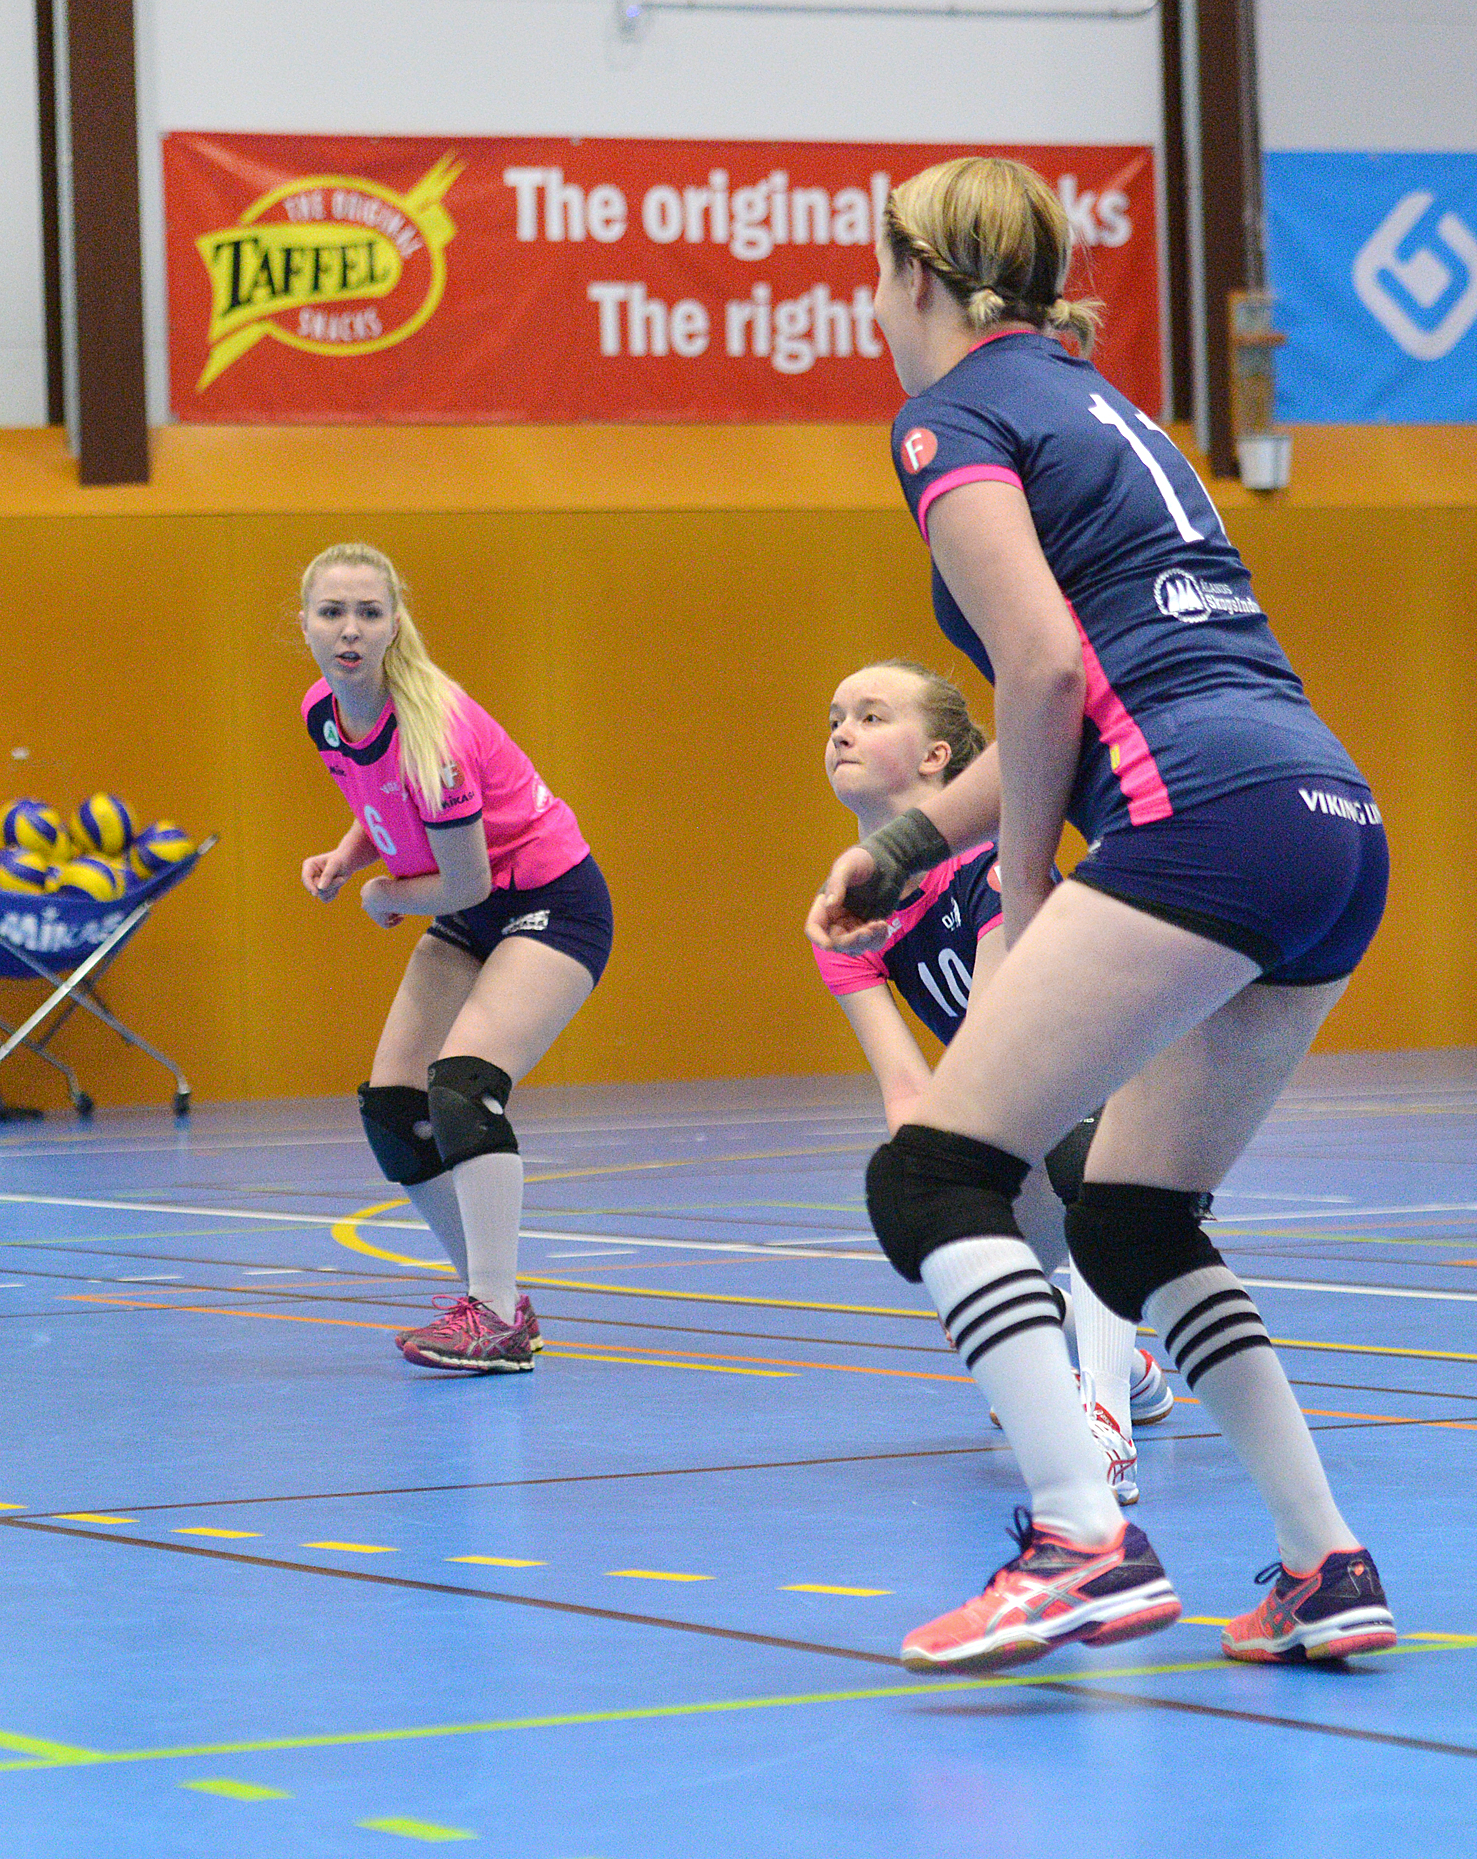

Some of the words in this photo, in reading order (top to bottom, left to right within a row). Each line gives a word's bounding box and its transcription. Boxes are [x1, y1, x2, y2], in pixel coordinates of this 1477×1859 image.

[502, 165, 627, 243] The
[641, 168, 892, 262] original
[214, 236, 392, 317] TAFFEL
[586, 281, 711, 358] The
[725, 282, 885, 375] right
[905, 432, 923, 471] F
[364, 804, 397, 856] 6
[1298, 788, 1367, 826] VIKING
[917, 948, 973, 1018] 10
